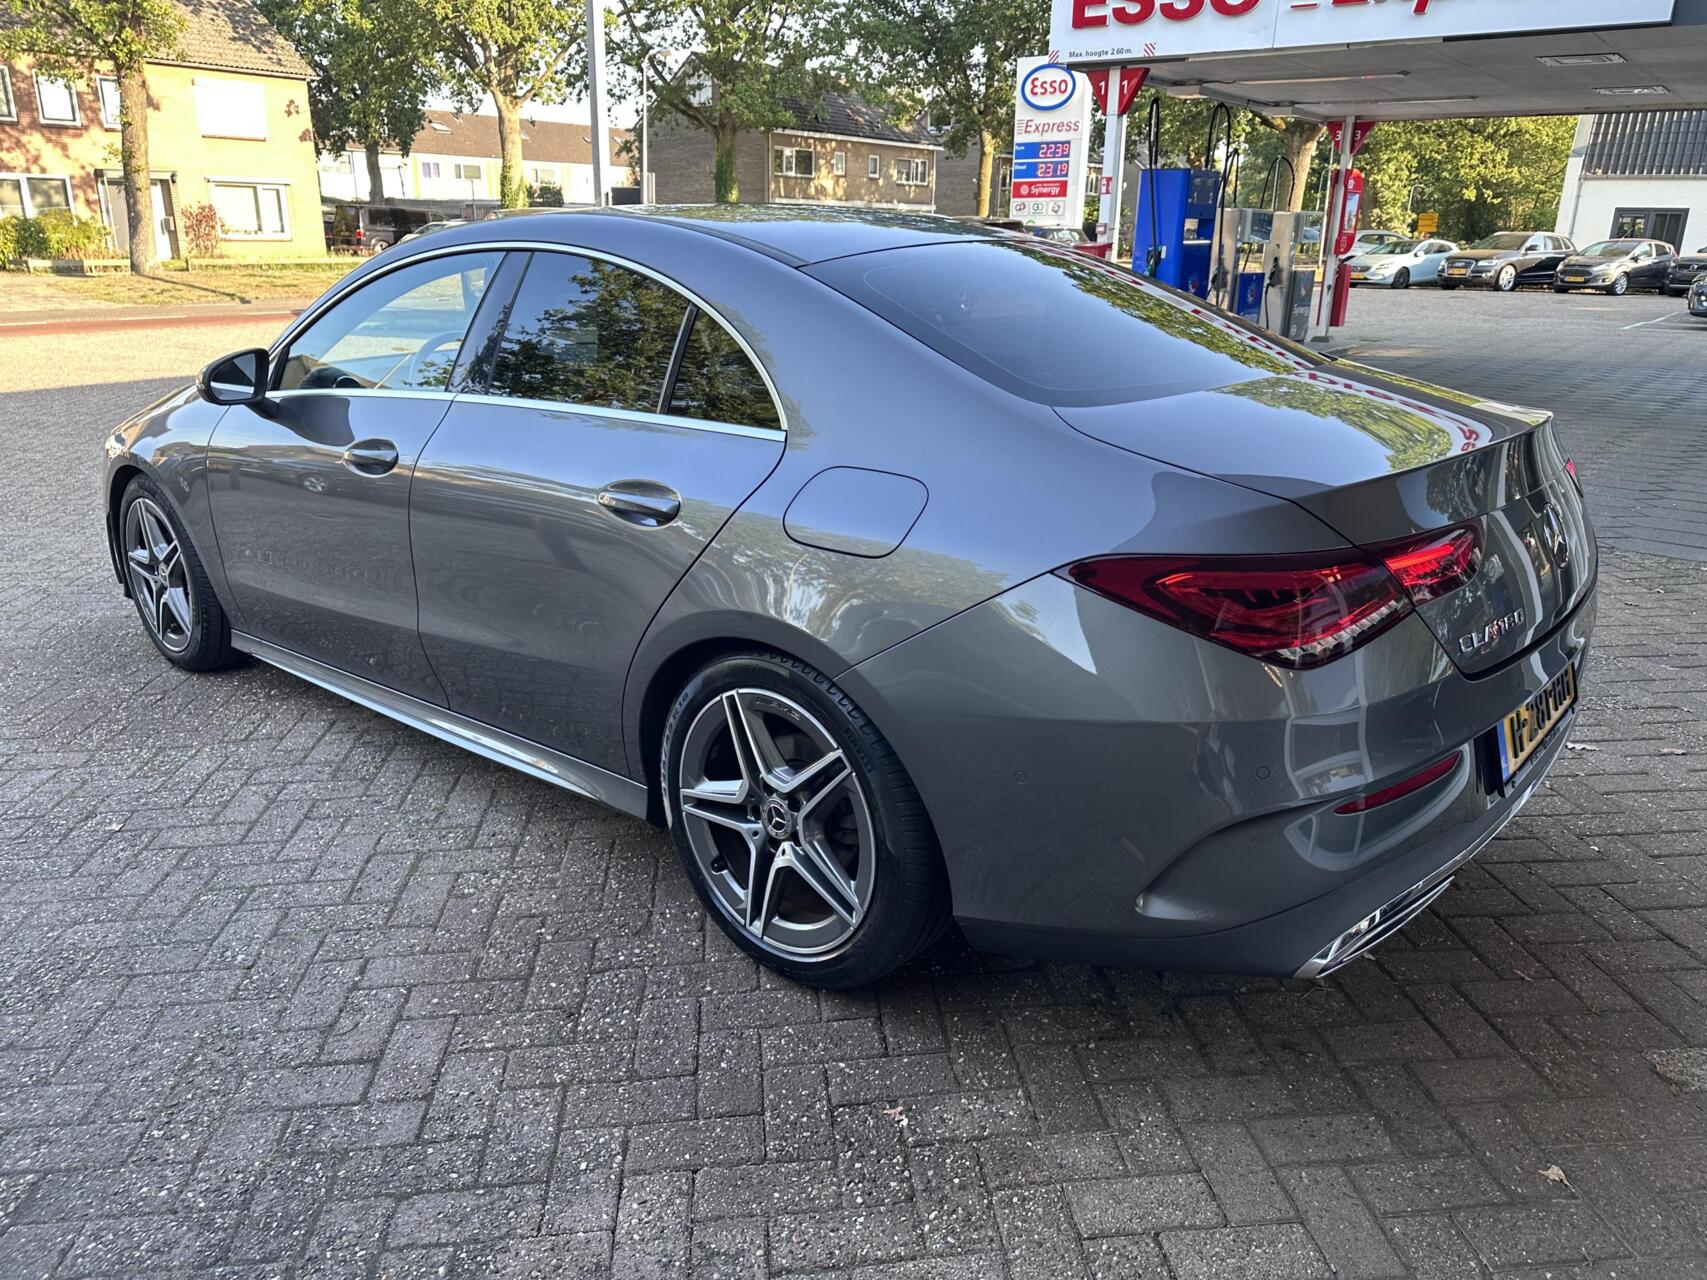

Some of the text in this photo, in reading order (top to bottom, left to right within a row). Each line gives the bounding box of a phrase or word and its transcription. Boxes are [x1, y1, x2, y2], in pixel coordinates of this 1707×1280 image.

[1085, 49, 1109, 57] hoogte
[1030, 77, 1068, 95] Esso
[1099, 81, 1105, 95] 1
[1122, 80, 1128, 94] 1
[1024, 119, 1080, 136] Express
[1335, 130, 1342, 140] 3
[1354, 130, 1361, 140] 3
[1030, 184, 1061, 196] Synergy
